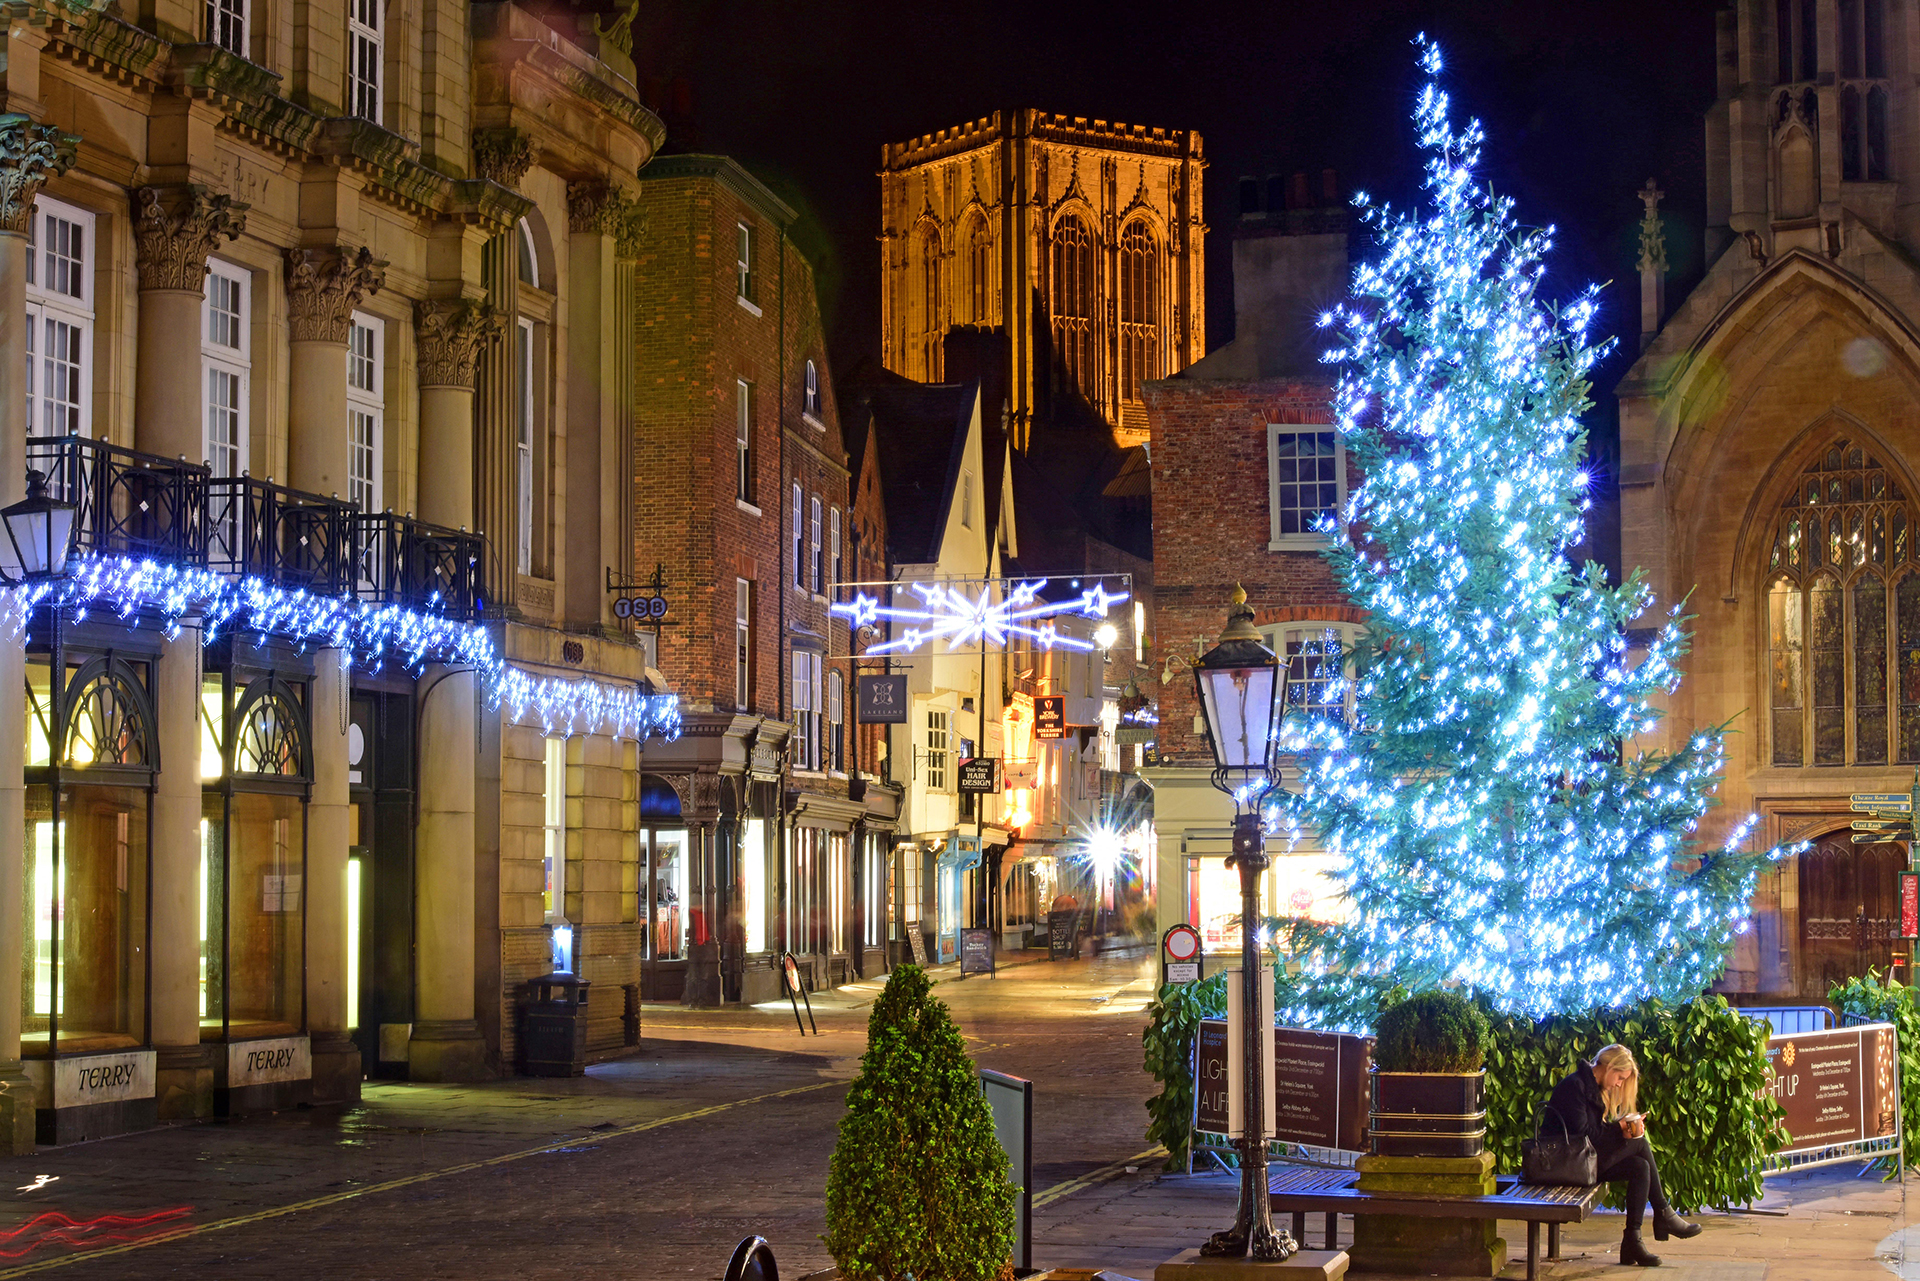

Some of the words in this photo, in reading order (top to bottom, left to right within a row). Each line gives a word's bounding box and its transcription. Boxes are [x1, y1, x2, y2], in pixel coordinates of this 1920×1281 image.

[213, 157, 269, 204] ERRY
[616, 601, 664, 616] TSB
[247, 1048, 295, 1072] TERRY
[1202, 1059, 1228, 1080] LIGH
[78, 1062, 136, 1091] TERRY
[1787, 1074, 1800, 1097] UP
[1200, 1090, 1209, 1110] A
